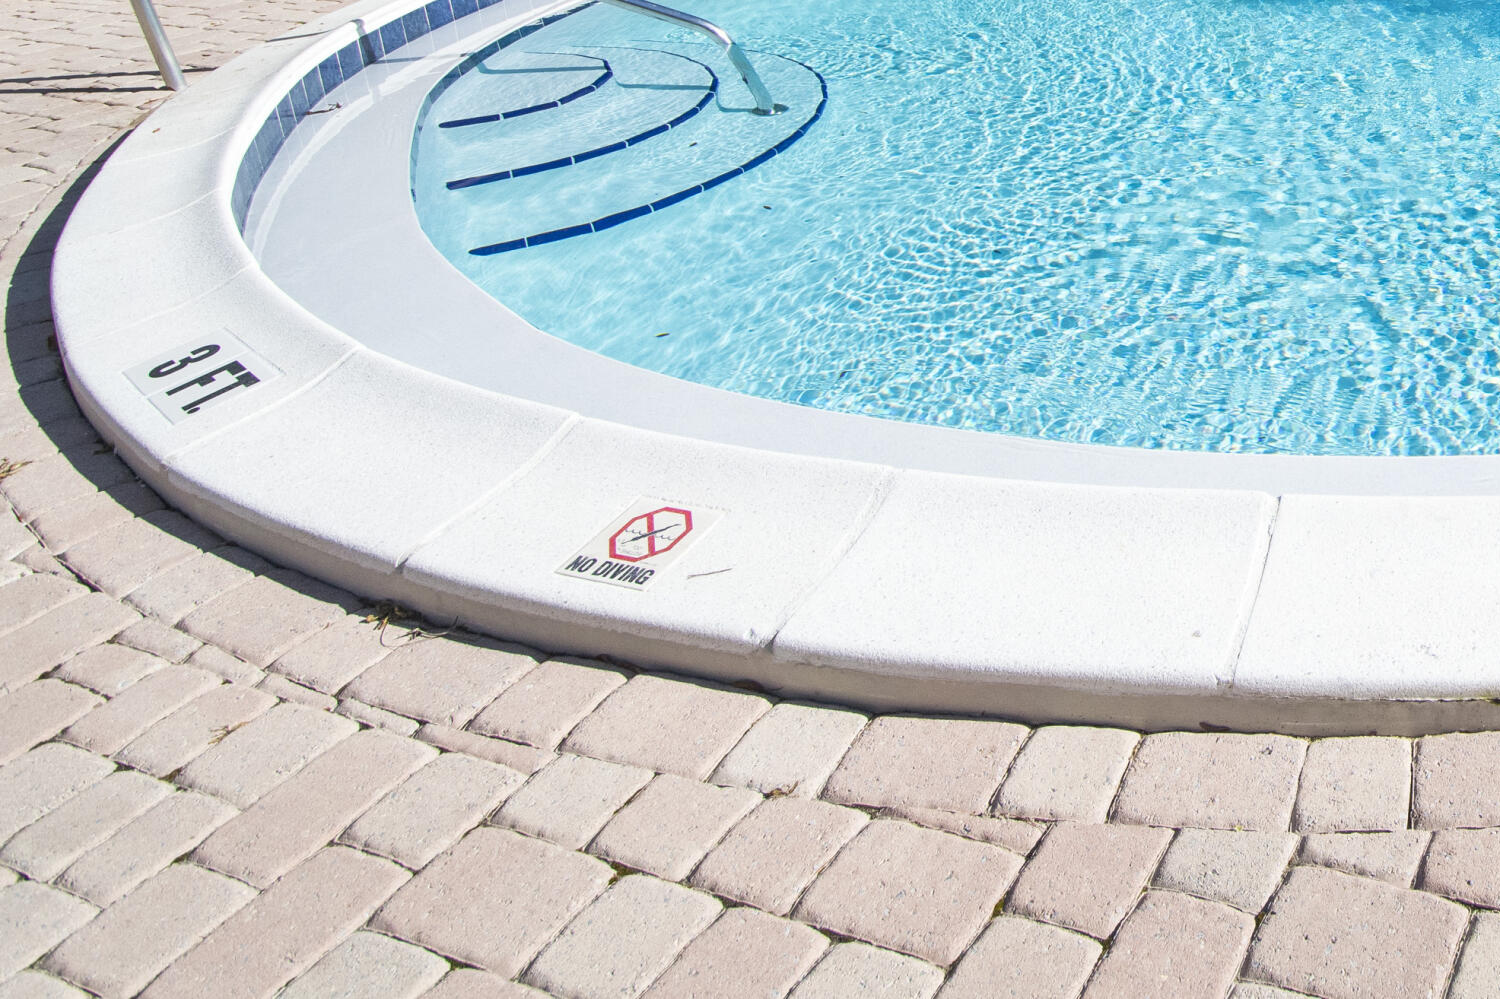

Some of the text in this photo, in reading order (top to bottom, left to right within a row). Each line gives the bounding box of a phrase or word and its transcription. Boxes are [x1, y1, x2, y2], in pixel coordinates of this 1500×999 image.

[148, 344, 221, 378] 3
[565, 554, 655, 585] NO DIVING
